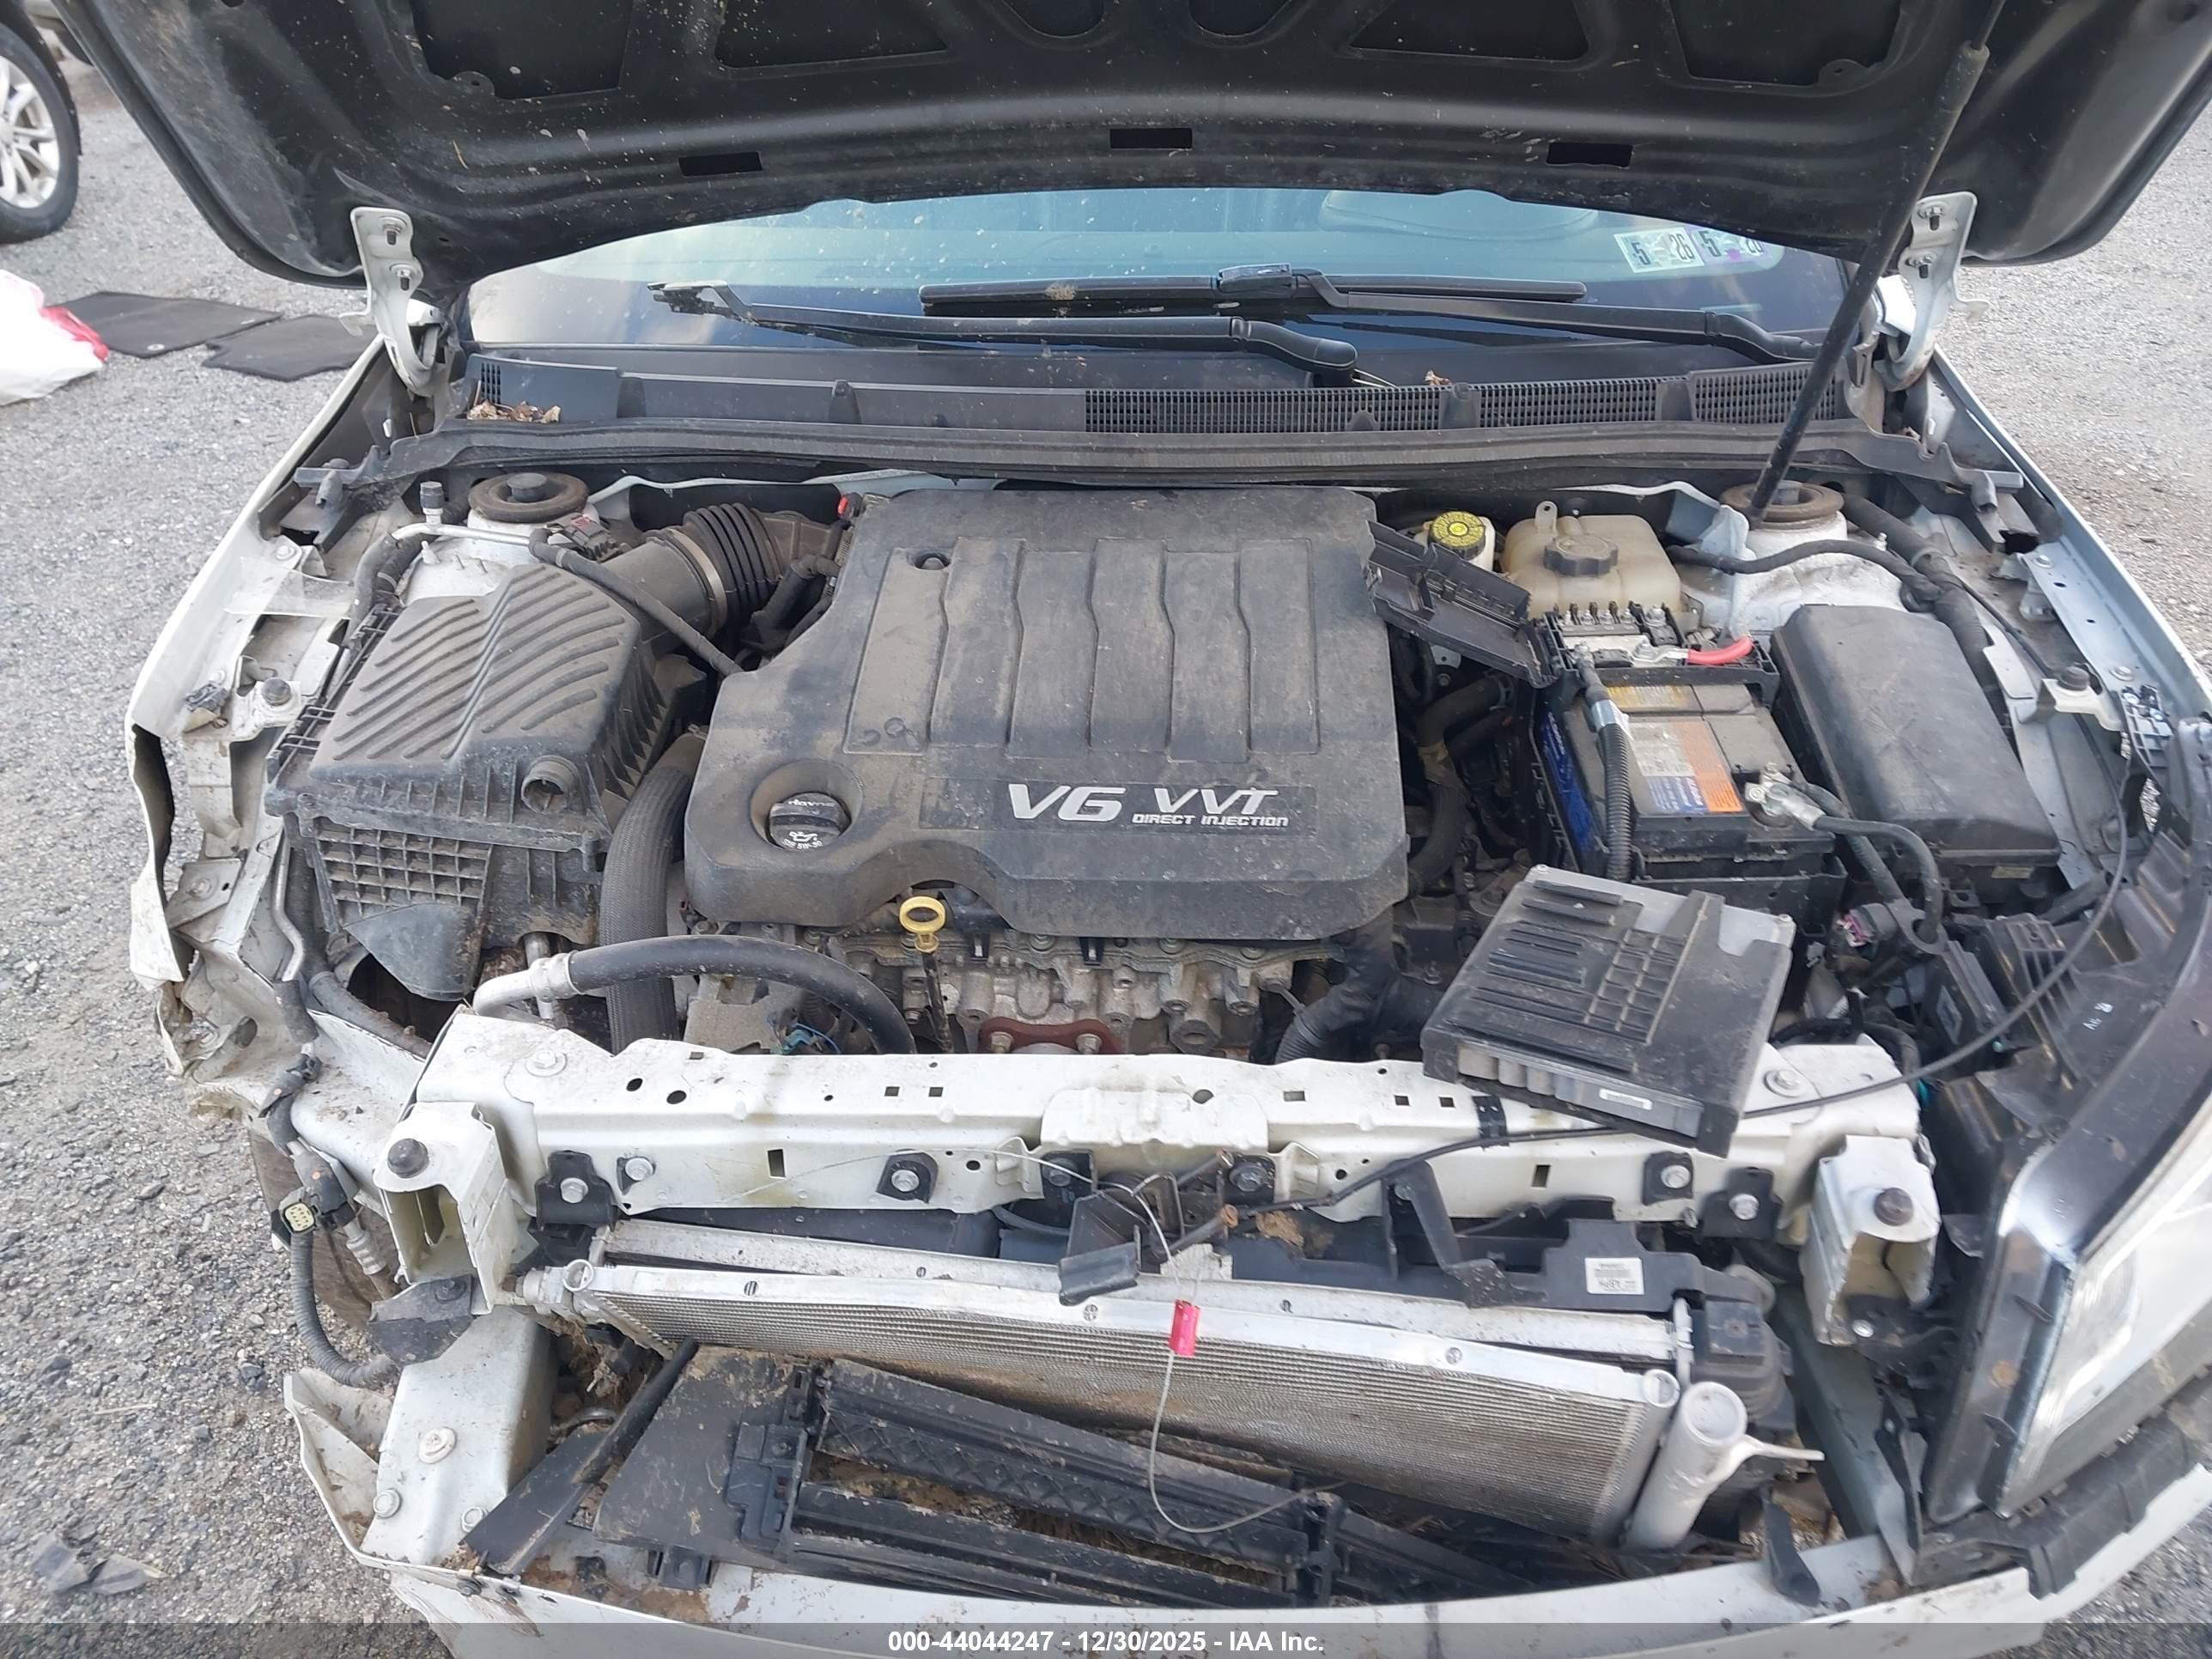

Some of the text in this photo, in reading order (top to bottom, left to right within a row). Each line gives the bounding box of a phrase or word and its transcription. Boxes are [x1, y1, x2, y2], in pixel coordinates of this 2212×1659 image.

[1631, 233, 1696, 265] 5 26
[1698, 230, 1722, 257] 5
[1008, 782, 1279, 822] V6 VVT
[1132, 813, 1290, 827] DIRECT INJECTION
